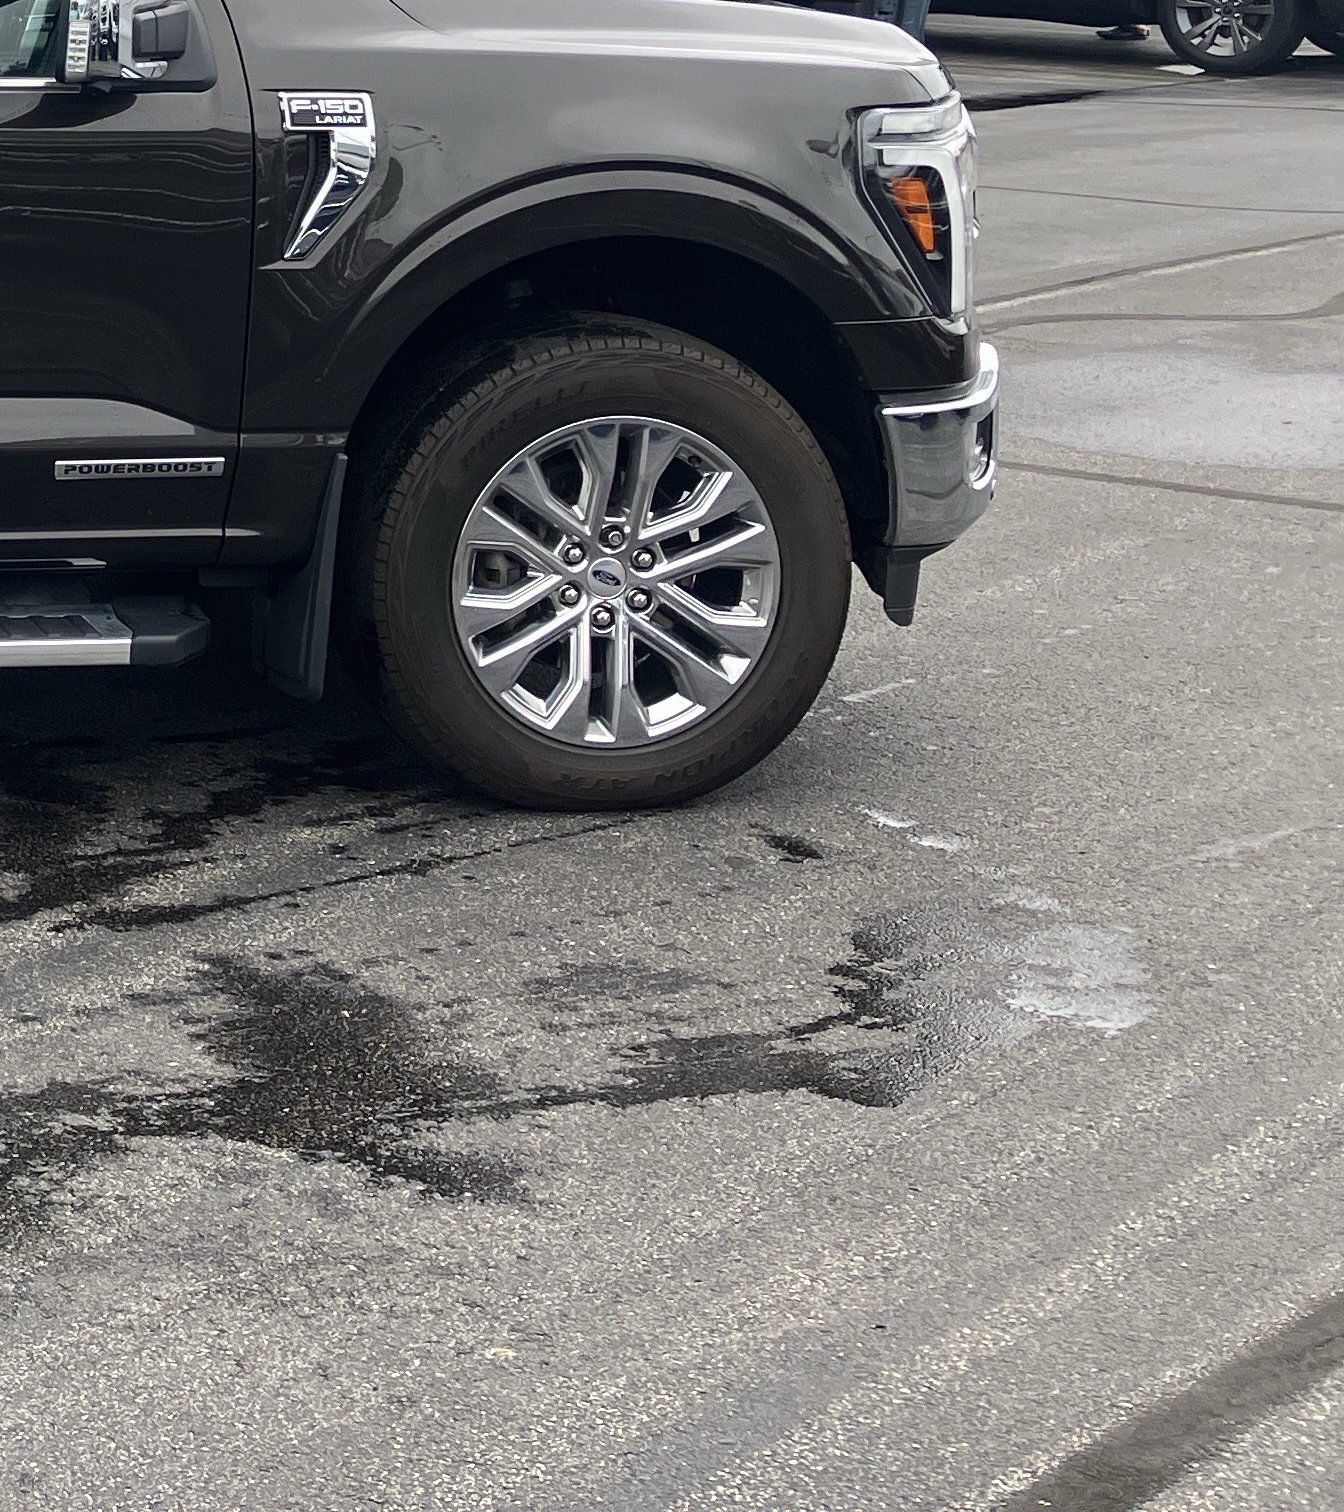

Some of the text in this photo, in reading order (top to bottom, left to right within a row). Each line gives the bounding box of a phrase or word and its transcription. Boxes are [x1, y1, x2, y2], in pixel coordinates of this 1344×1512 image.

[290, 99, 365, 114] F-150
[315, 115, 363, 124] LARIAT
[63, 461, 217, 475] POWERBOOST
